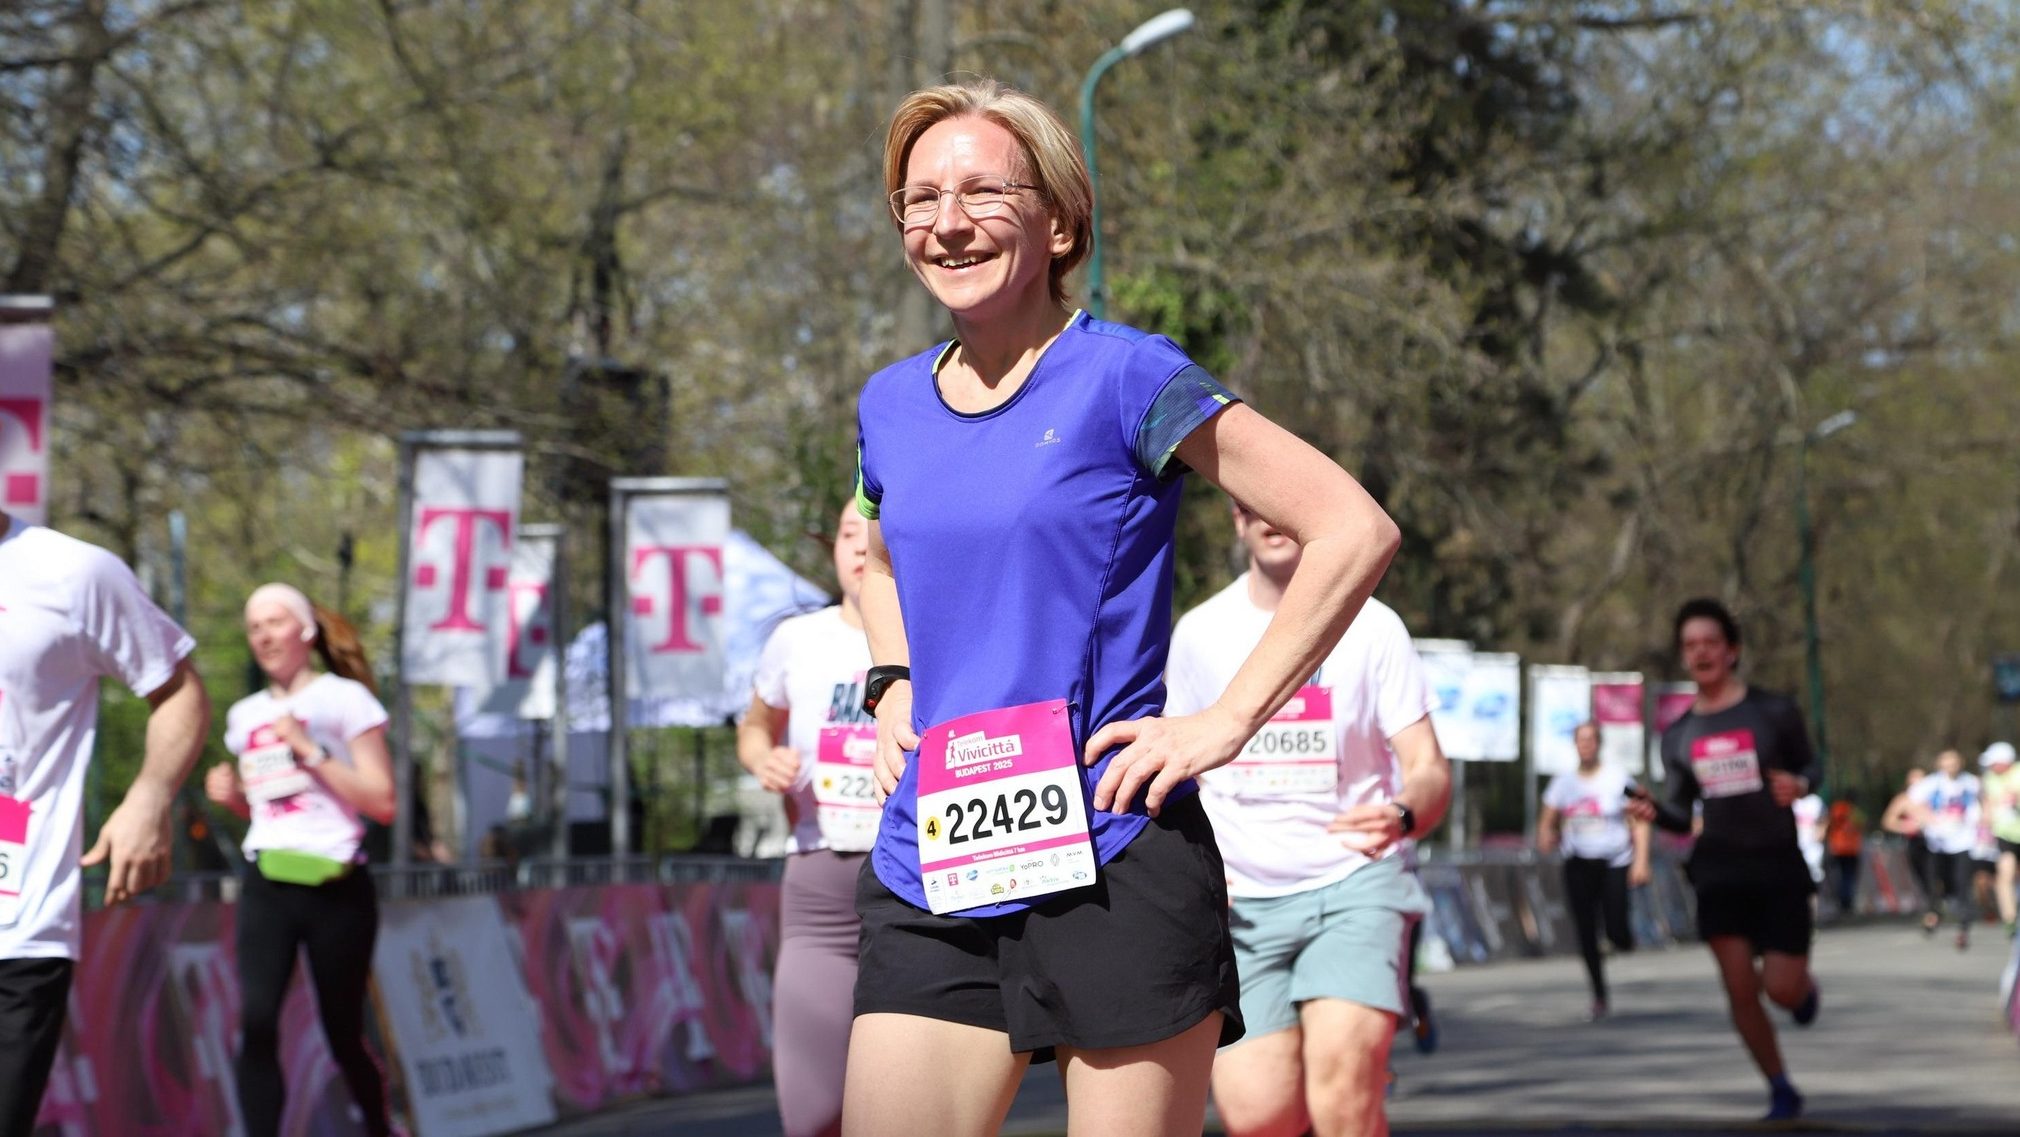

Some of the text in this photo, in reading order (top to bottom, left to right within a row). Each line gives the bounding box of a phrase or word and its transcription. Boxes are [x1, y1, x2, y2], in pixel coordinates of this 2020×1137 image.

[1249, 731, 1327, 753] 20685
[955, 759, 1013, 778] BUDAPEST 2025
[840, 775, 876, 798] 22
[946, 784, 1068, 845] 22429
[927, 820, 937, 836] 4
[1020, 860, 1044, 871] YoPRO
